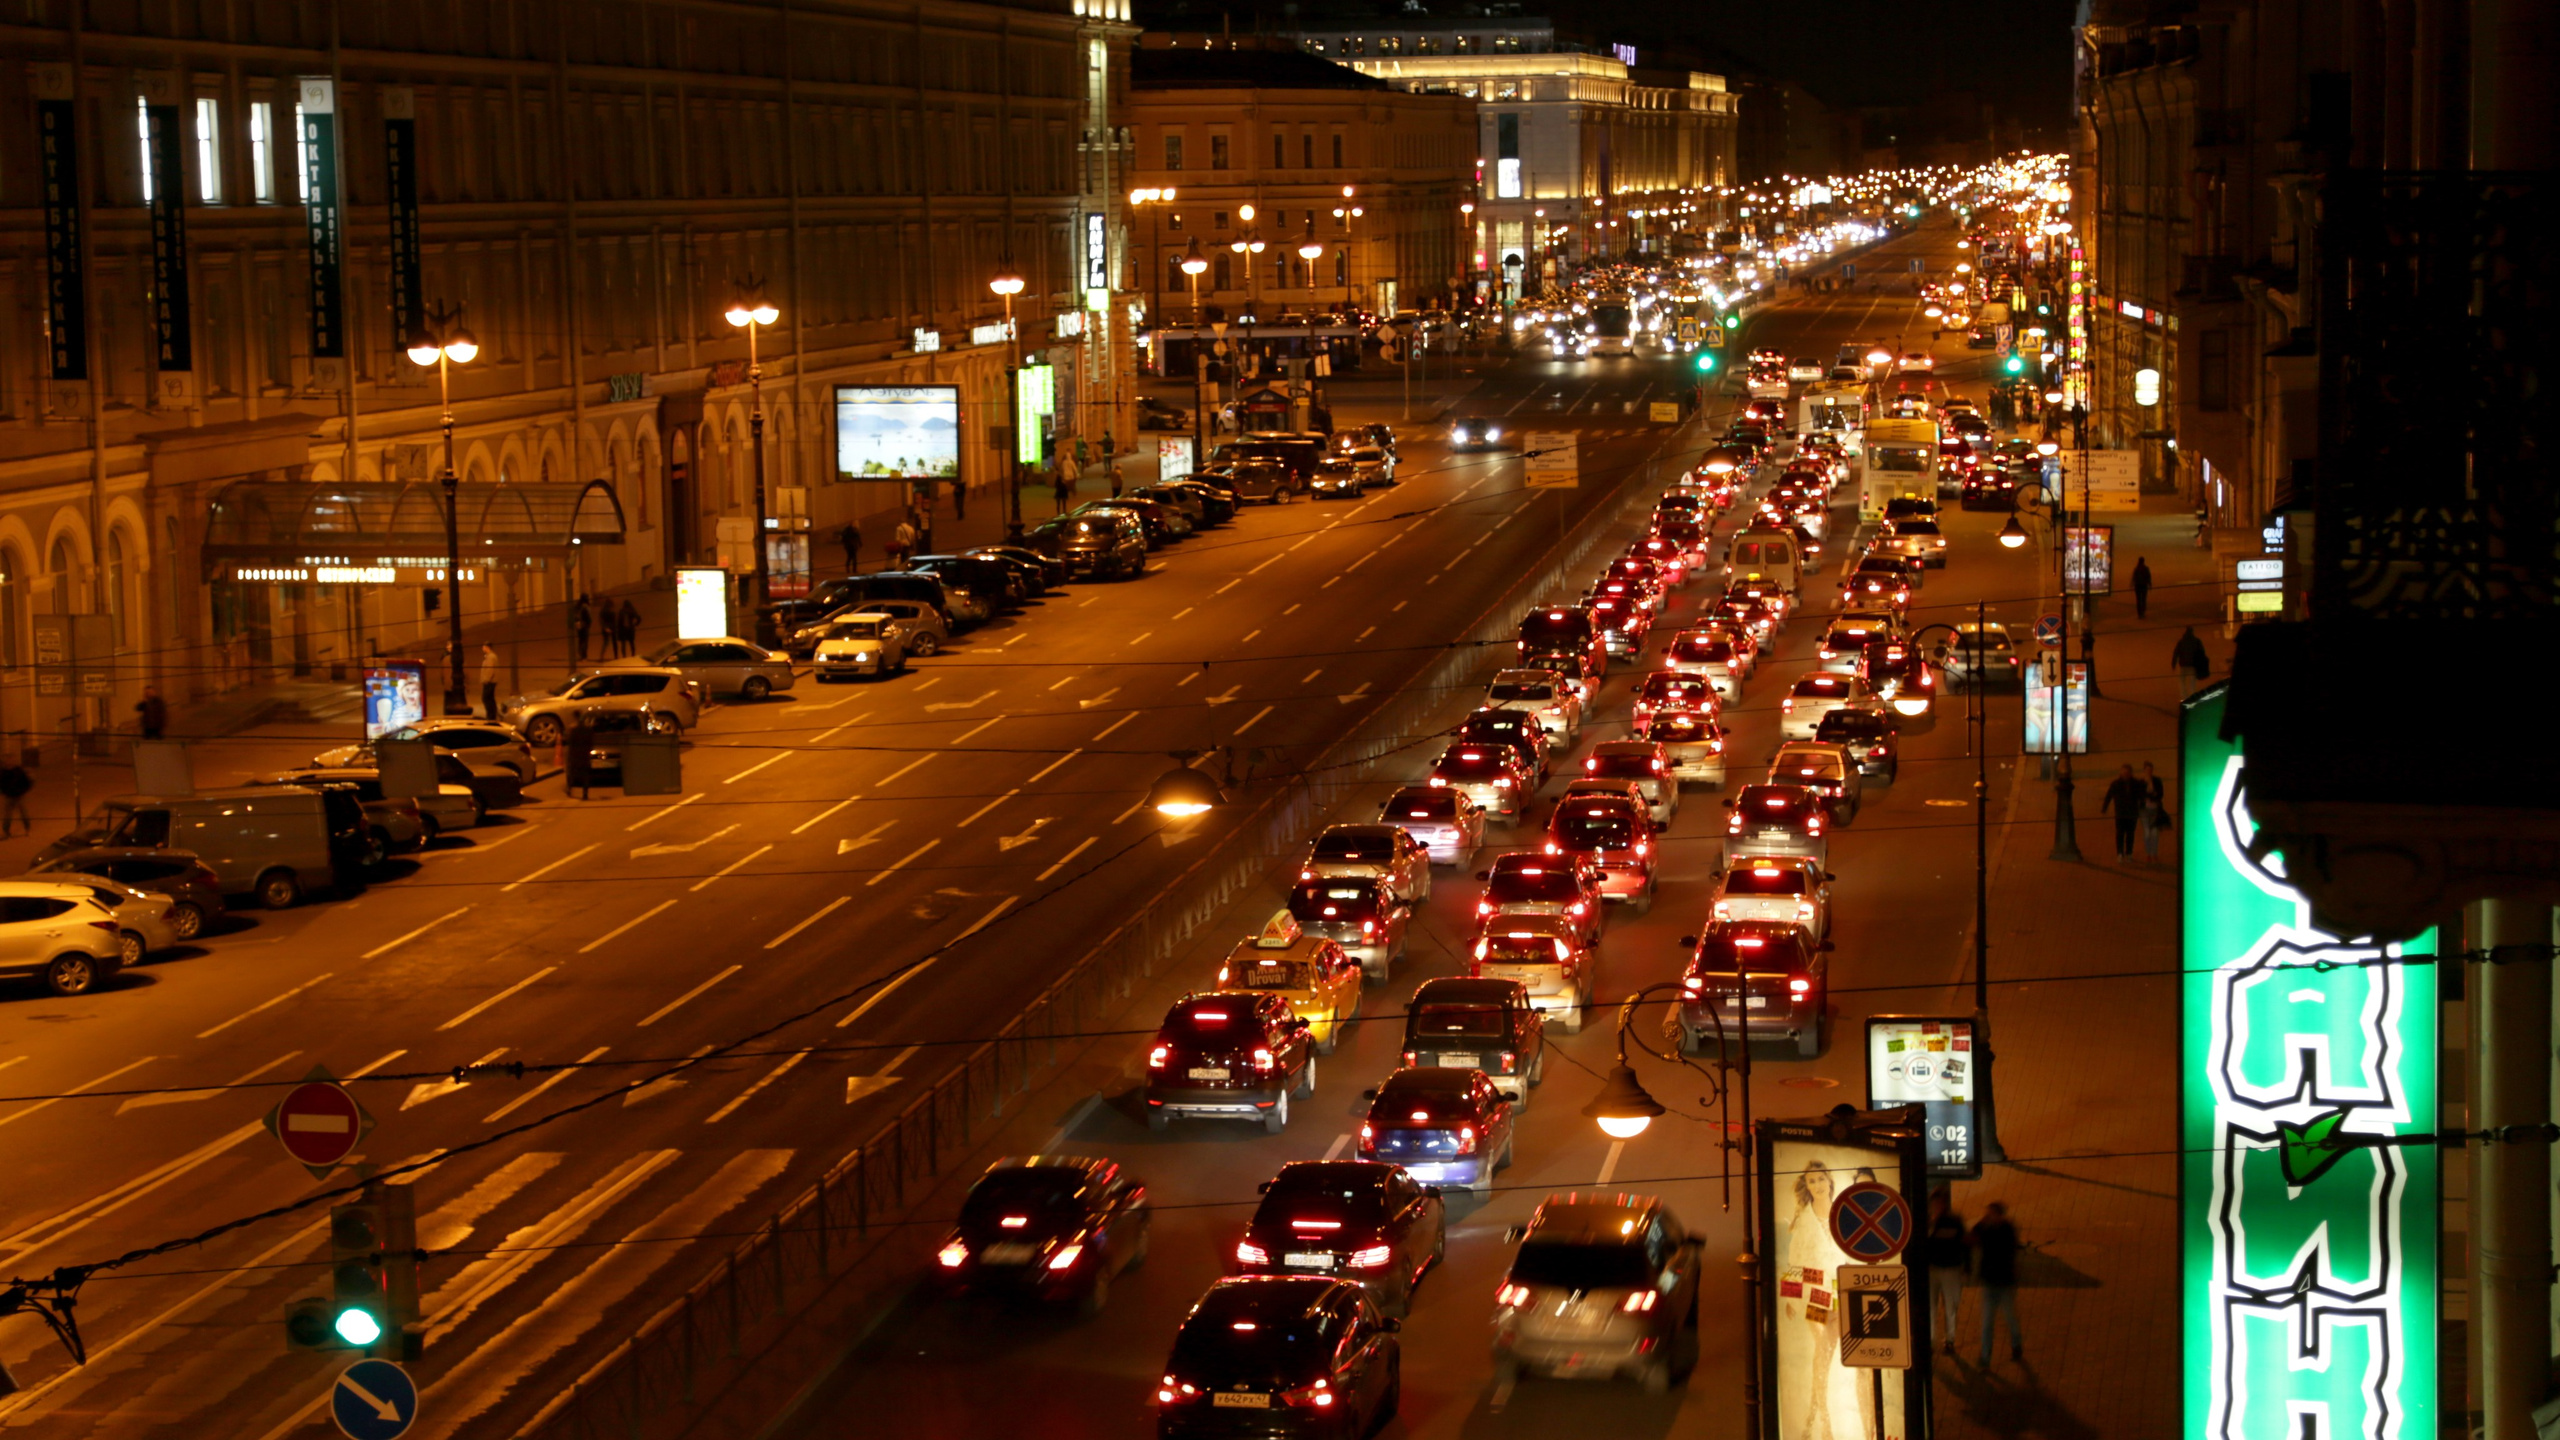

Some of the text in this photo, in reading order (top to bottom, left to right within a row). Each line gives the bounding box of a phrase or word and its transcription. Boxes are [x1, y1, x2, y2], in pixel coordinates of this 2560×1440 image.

[307, 123, 328, 349] ОКТЯБРЬСКАЯ
[327, 207, 336, 265] HOTEL
[1089, 215, 1105, 288] КНИГИ
[1248, 970, 1286, 986] Drova!
[1781, 1127, 1813, 1137] POSTER
[1946, 1126, 1967, 1141] 02
[1871, 1137, 1896, 1148] POSTER
[1941, 1149, 1967, 1164] 112
[1853, 1274, 1890, 1285] ЗОНА
[1879, 1348, 1892, 1357] 20
